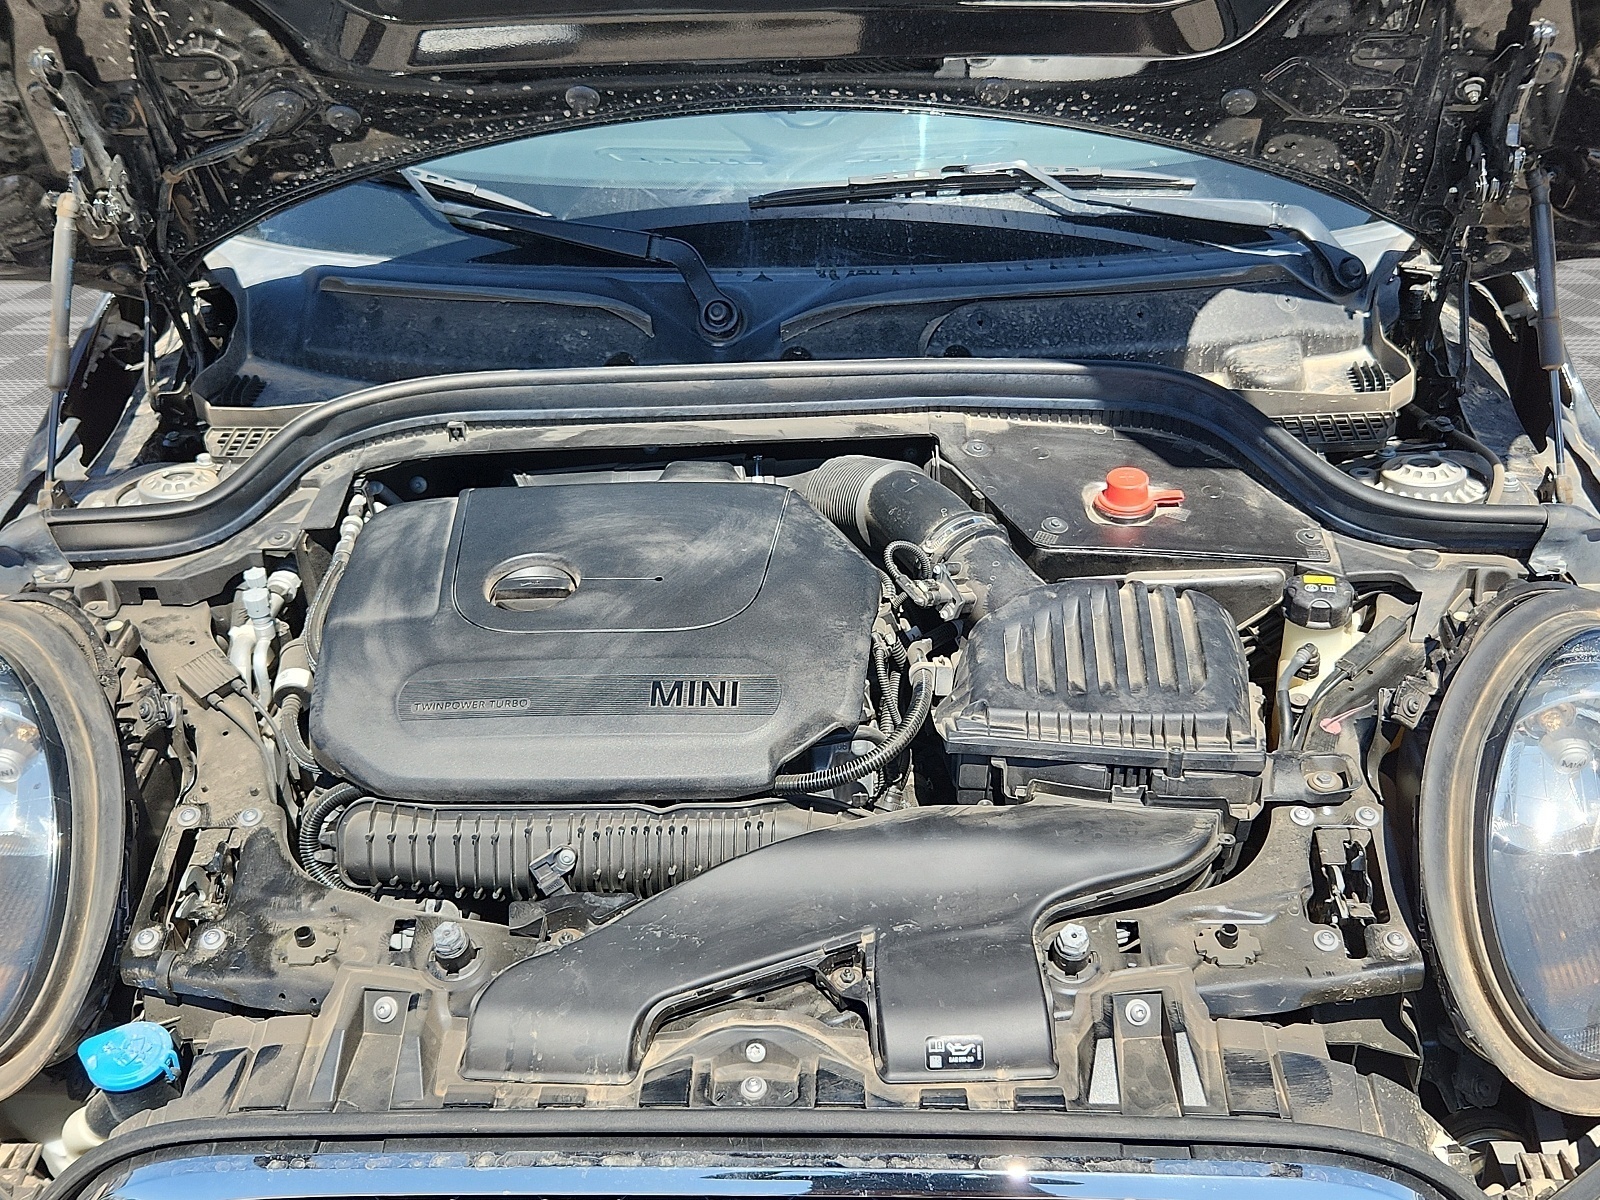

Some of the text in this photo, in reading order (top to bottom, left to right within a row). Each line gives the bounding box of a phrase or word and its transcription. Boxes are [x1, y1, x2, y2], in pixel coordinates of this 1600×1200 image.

[650, 680, 740, 707] MINI
[413, 698, 529, 712] TWINPOWER TURBO
